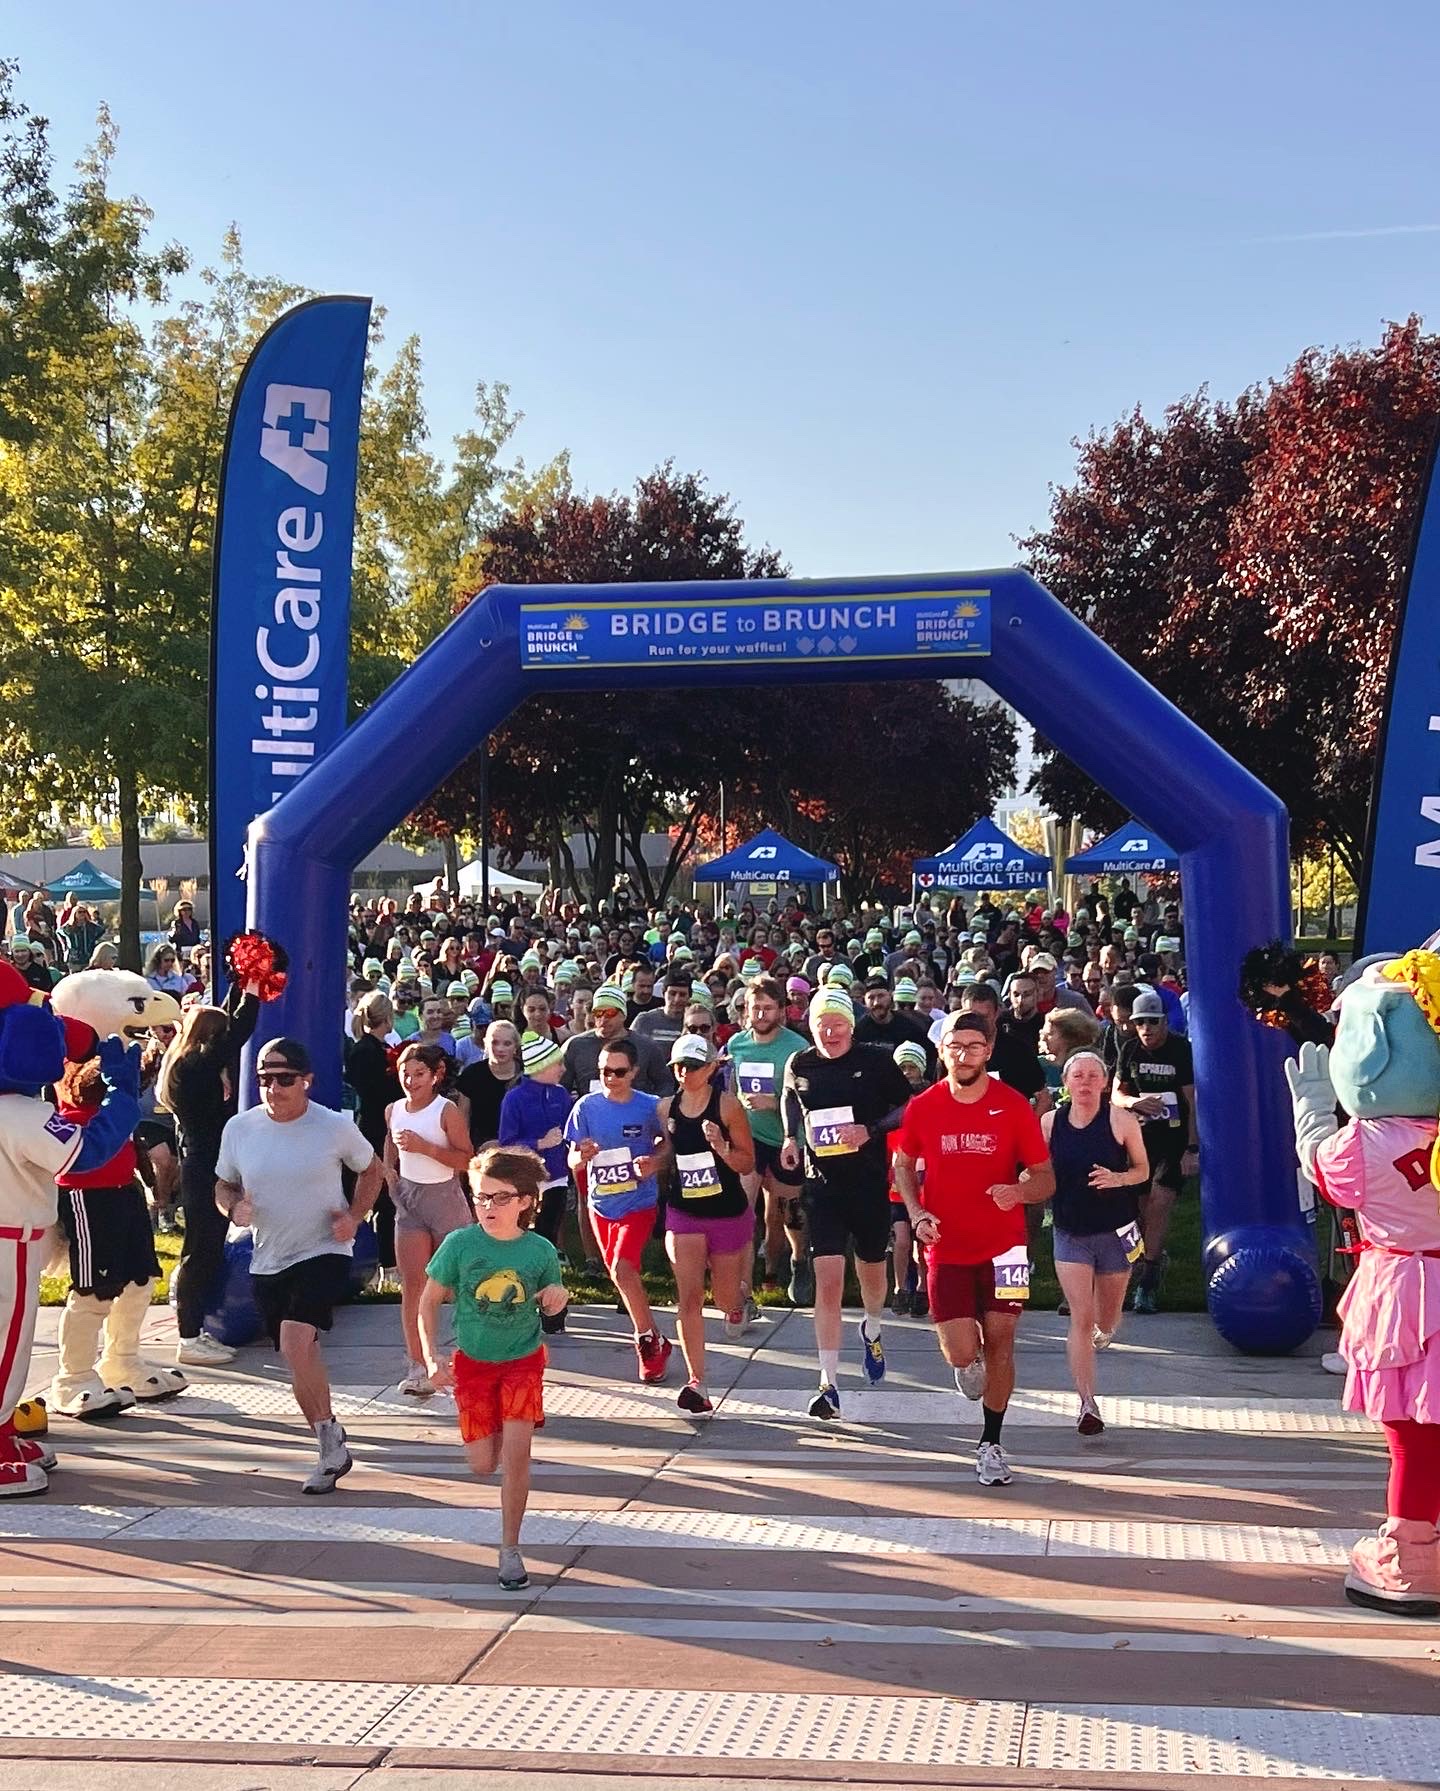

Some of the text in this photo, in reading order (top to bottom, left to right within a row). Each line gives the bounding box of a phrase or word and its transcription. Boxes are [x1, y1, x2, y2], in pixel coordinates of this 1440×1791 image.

[610, 605, 897, 636] BRIDGE to BRUNCH
[916, 618, 964, 631] BRIDGE
[527, 631, 584, 642] BRIDGE to
[916, 629, 969, 642] BRUNCH
[251, 506, 324, 803] ltiCare
[527, 642, 578, 654] BRUNCH
[648, 641, 787, 657] Run for your waffles!
[938, 860, 1006, 874] MultiCare
[1103, 860, 1152, 872] MultiCare
[730, 870, 776, 881] MultiCare
[937, 871, 1043, 886] MEDICAL TENT
[750, 1078, 762, 1093] 6
[597, 1164, 630, 1184] 245
[682, 1168, 715, 1187] 244
